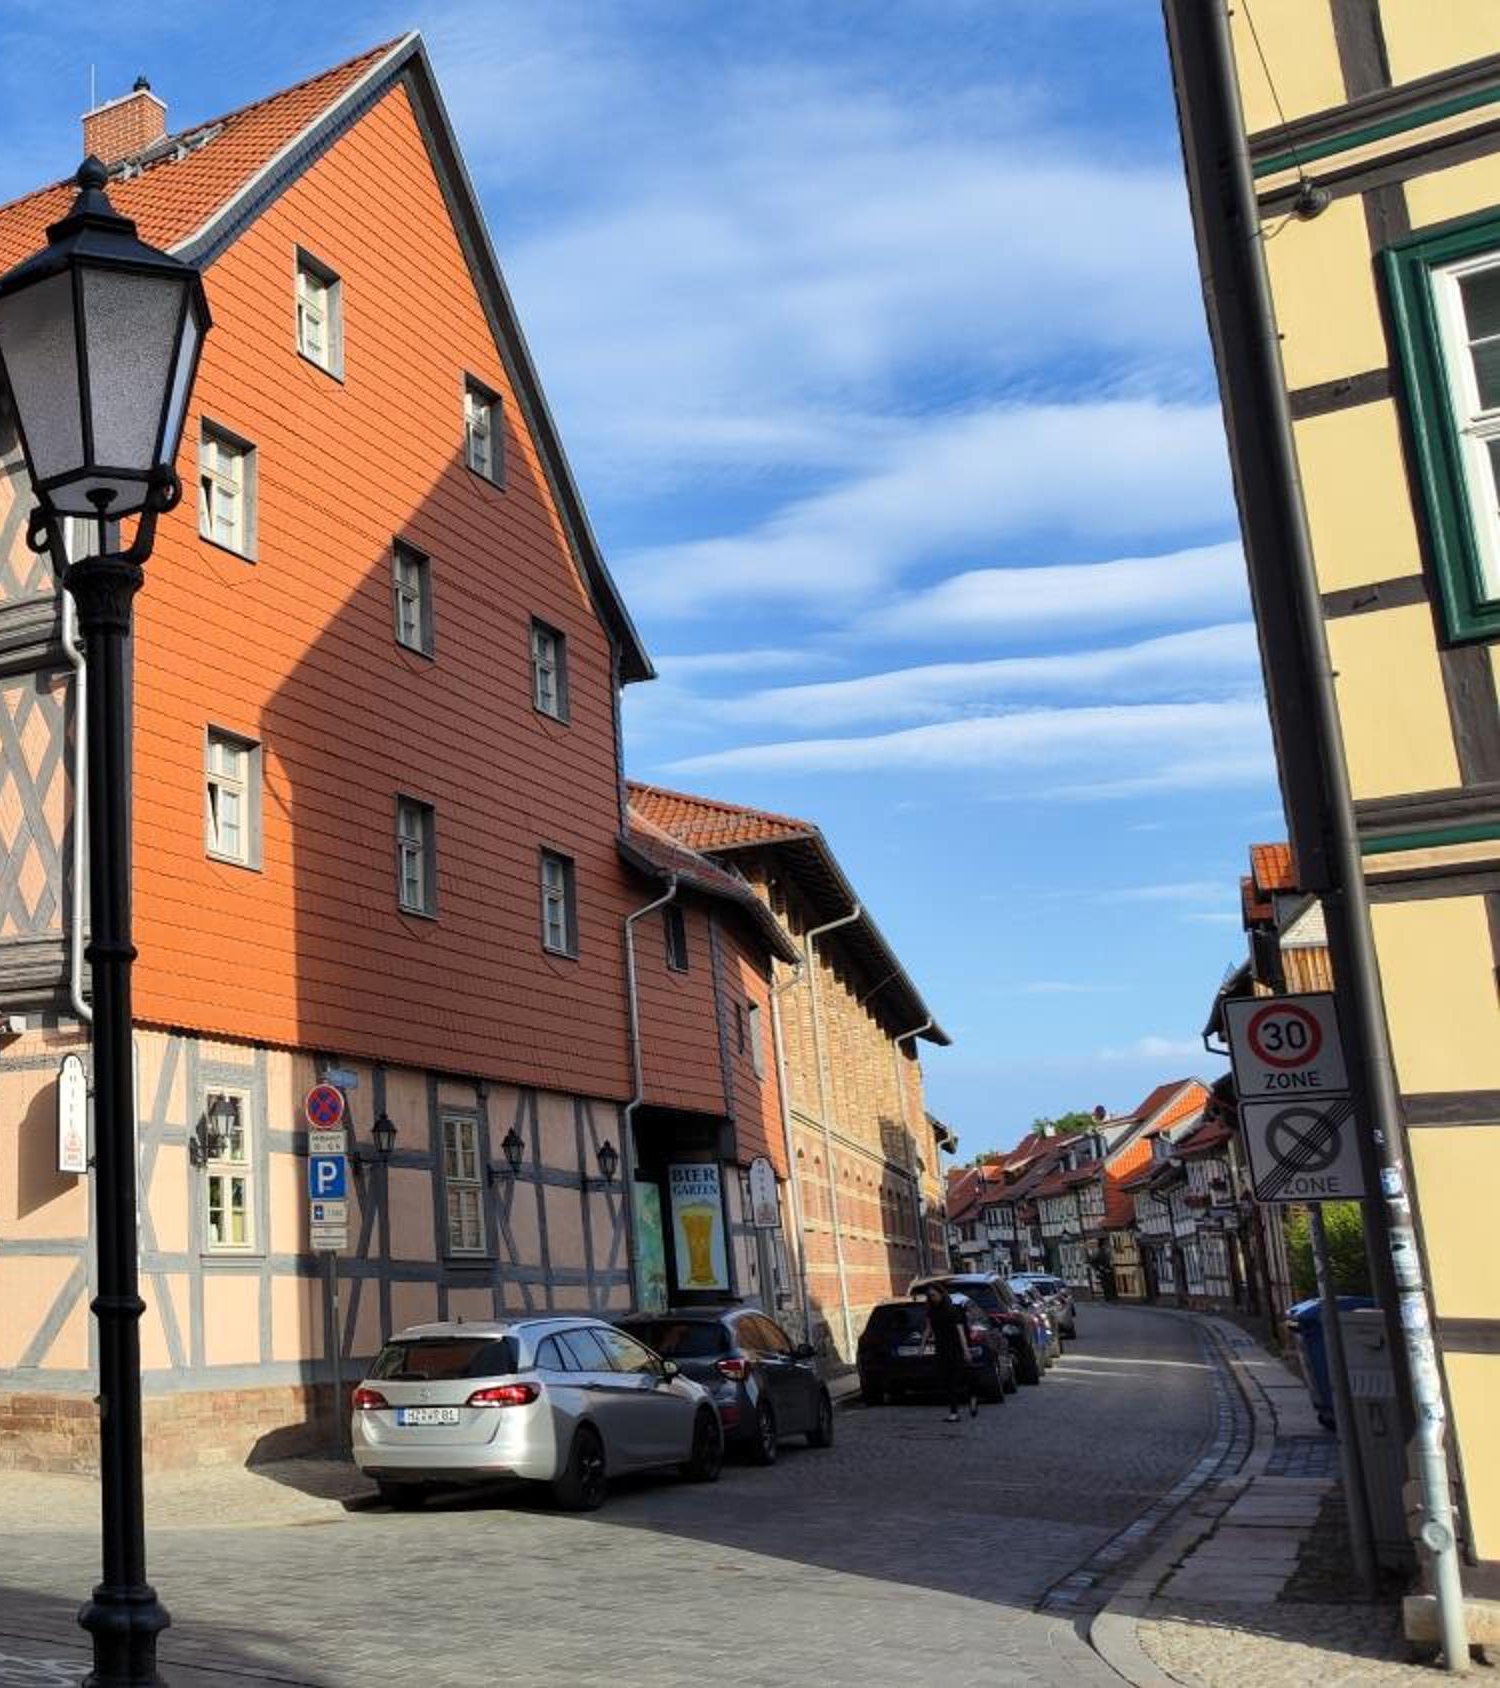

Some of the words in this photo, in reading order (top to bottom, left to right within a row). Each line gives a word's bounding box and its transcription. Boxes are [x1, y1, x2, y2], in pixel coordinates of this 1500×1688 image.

[1262, 1021, 1307, 1051] 30
[1264, 1071, 1322, 1089] ZONE
[317, 1161, 337, 1195] P
[671, 1167, 716, 1183] BIER
[673, 1184, 719, 1197] GARTEN
[1283, 1177, 1341, 1194] ZONE
